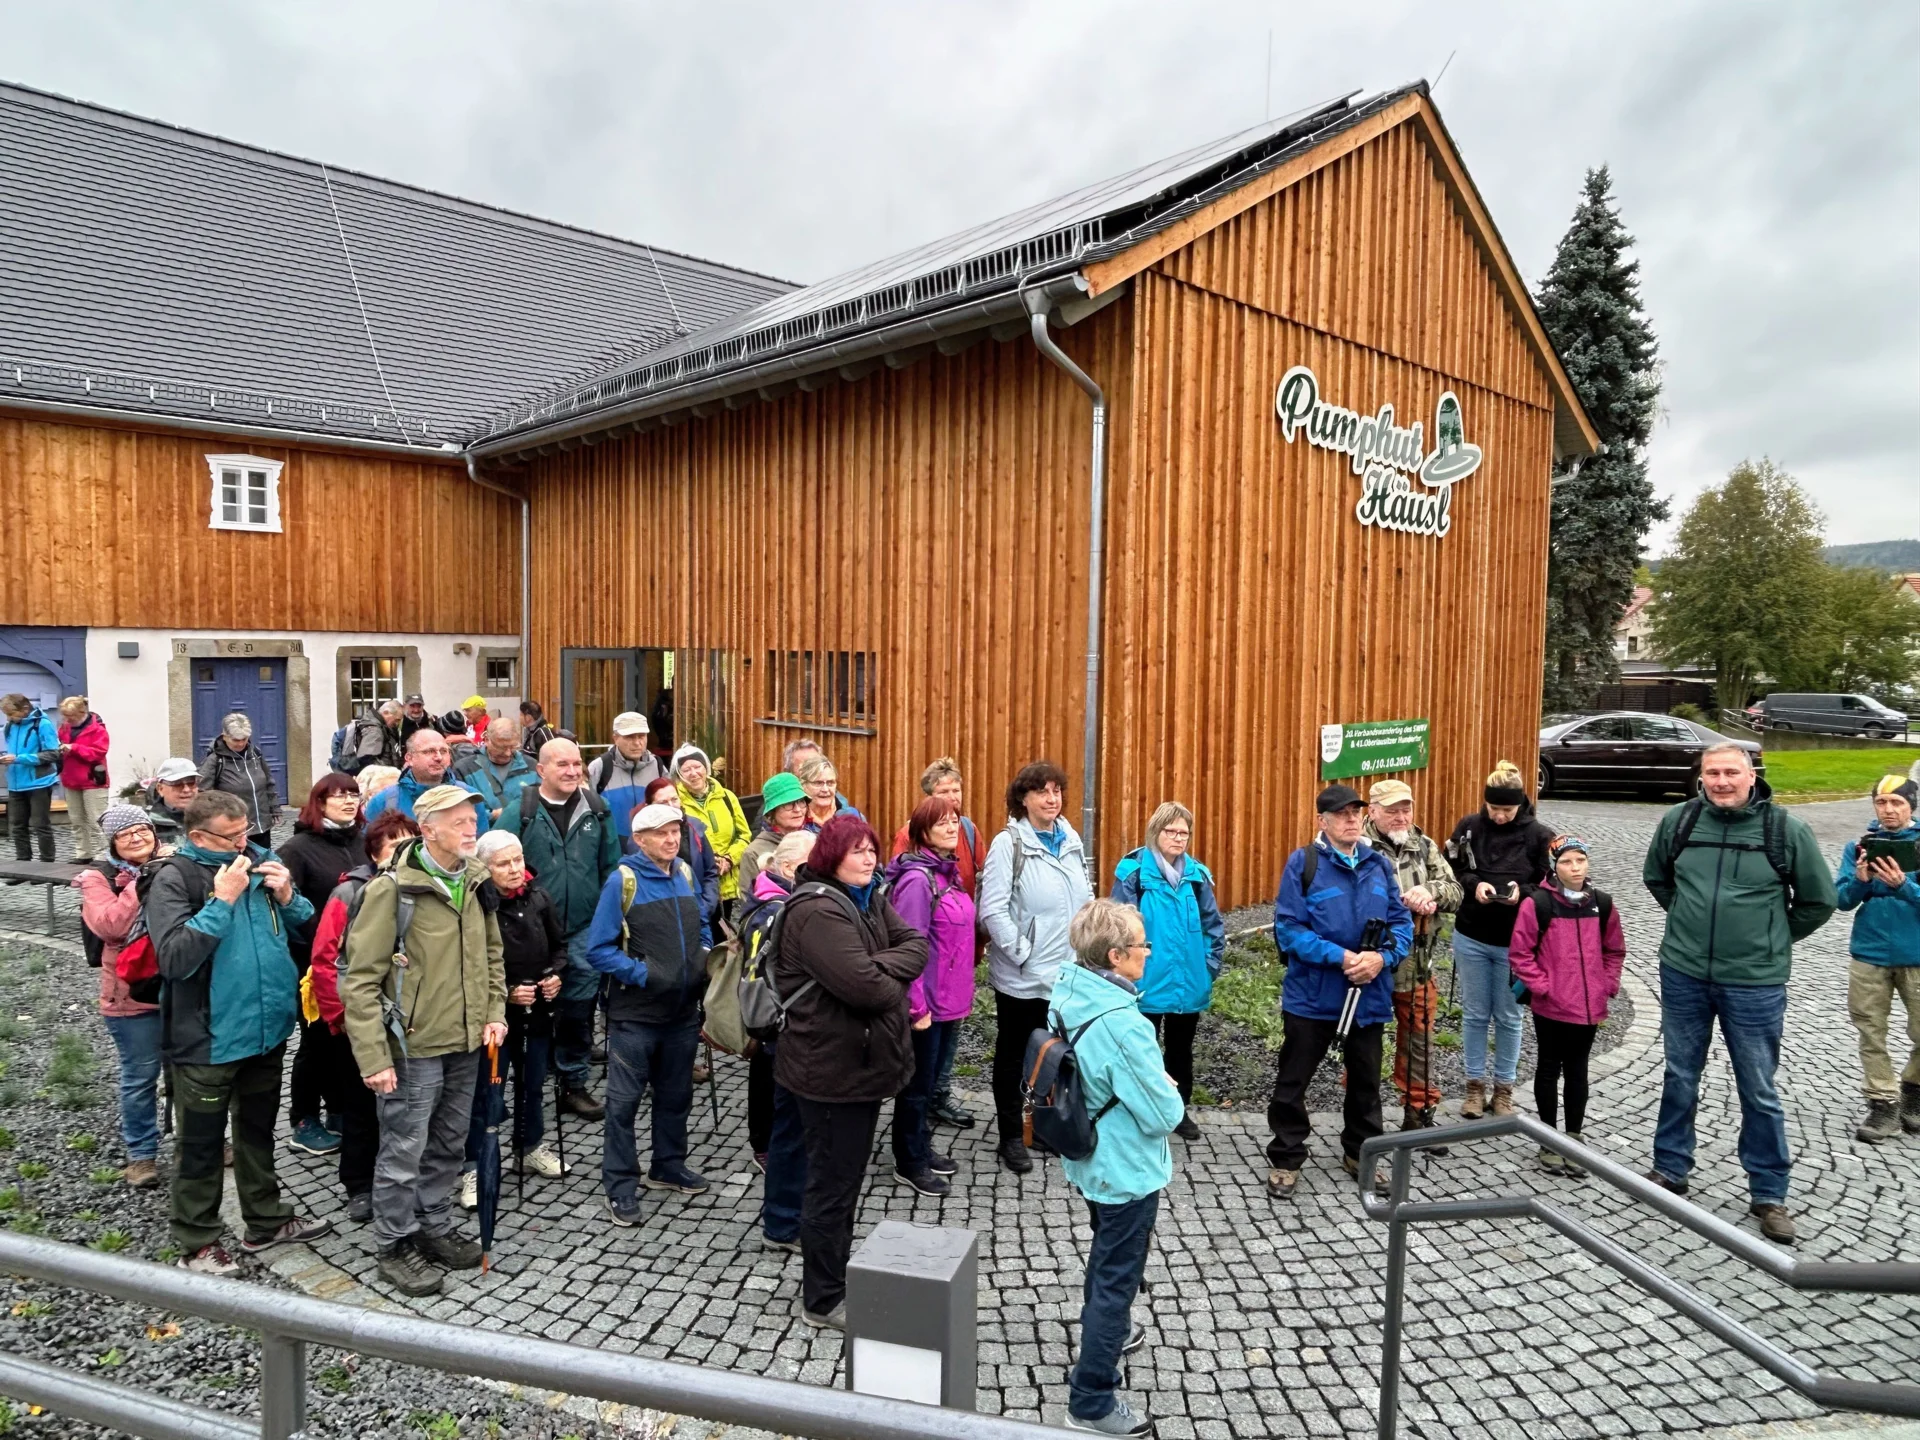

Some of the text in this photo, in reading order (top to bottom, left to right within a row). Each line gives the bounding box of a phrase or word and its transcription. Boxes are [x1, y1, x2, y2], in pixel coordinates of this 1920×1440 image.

[1281, 373, 1421, 469] Pumphut
[1360, 470, 1449, 532] Häusl
[1354, 727, 1403, 737] Verbandswandertag
[1362, 756, 1411, 771] 09./10.10.2026
